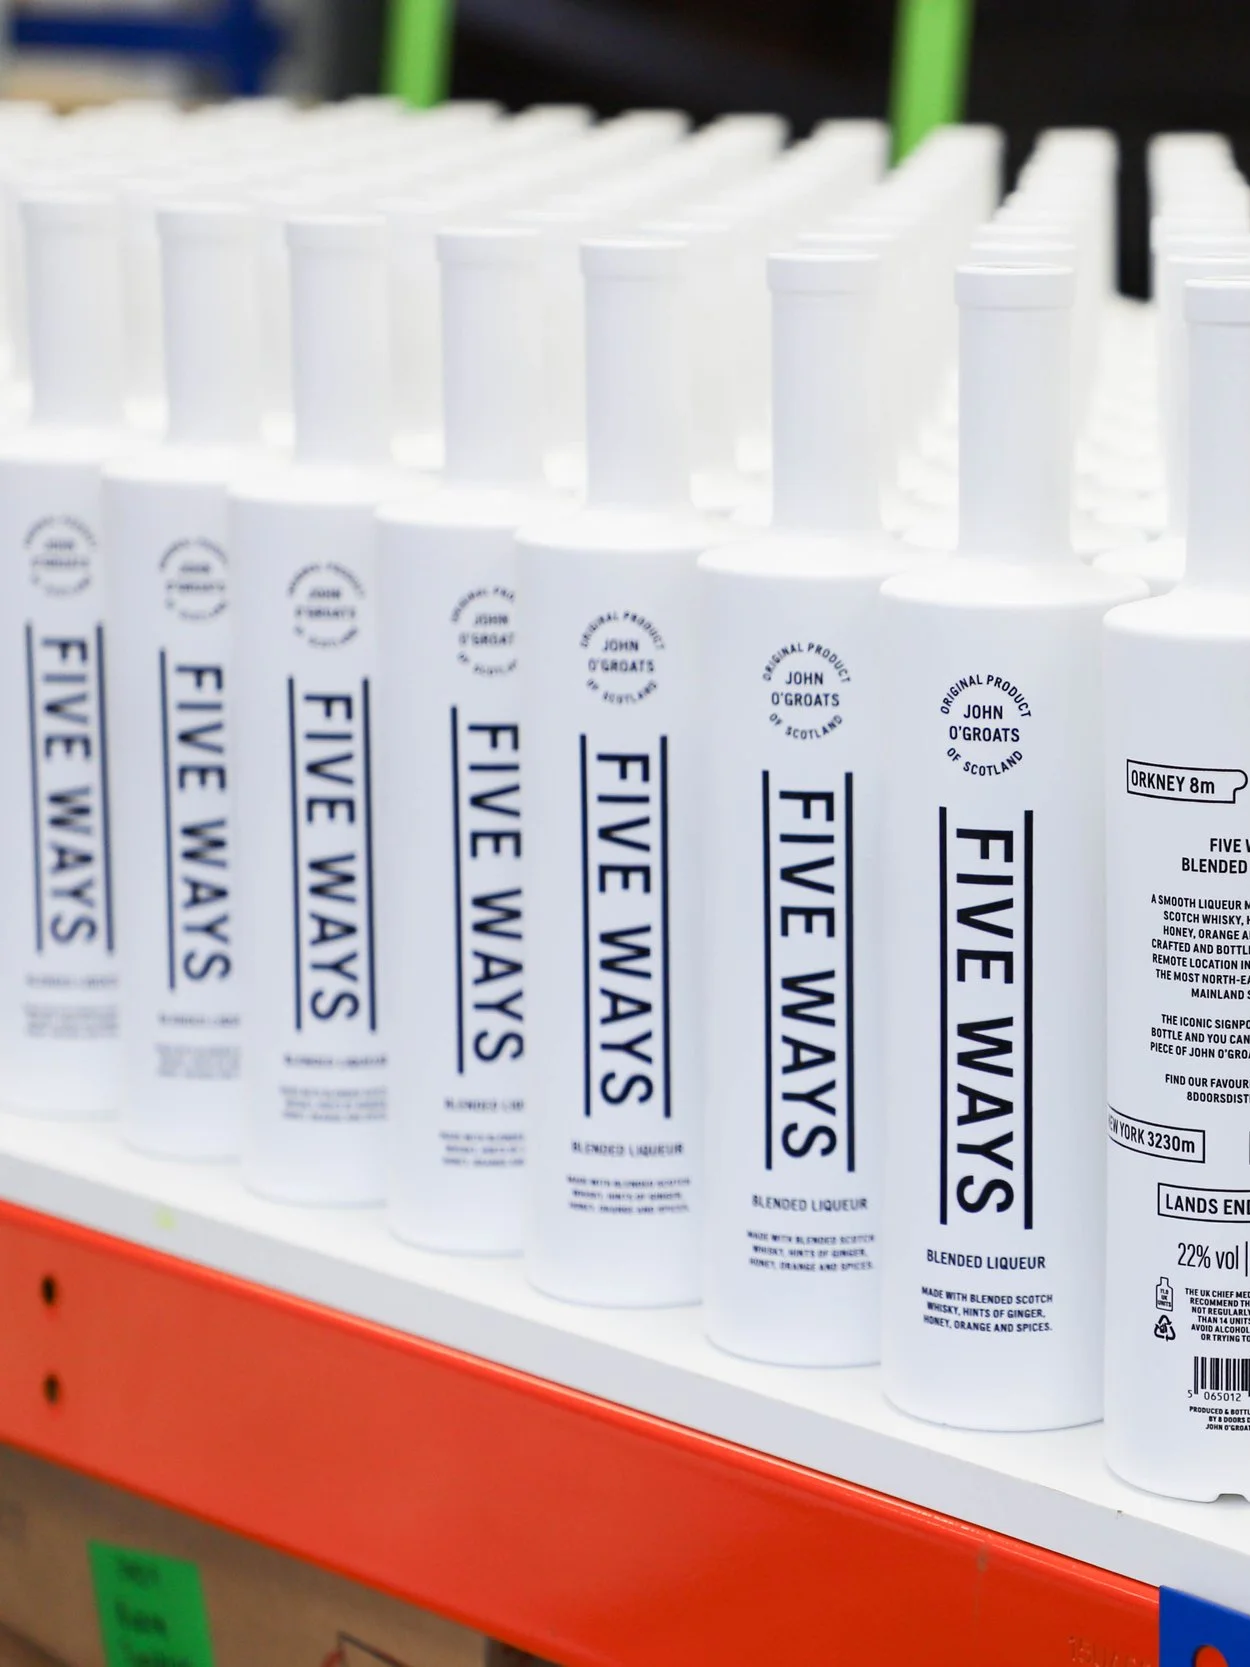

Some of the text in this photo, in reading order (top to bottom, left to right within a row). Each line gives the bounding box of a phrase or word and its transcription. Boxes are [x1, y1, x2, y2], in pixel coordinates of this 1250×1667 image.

[785, 671, 824, 686] JOHN
[771, 691, 840, 707] O'GROATS
[940, 674, 1032, 720] ORIGINAL PRODUCT
[963, 704, 1003, 720] JOHN
[174, 664, 228, 793] FIVE
[949, 725, 1020, 743] O'GROATS
[303, 692, 357, 826] FIVE
[946, 747, 1023, 777] OF SCOTLAND
[466, 722, 523, 860] FIVE
[1131, 769, 1215, 795] ORKNEY 8m
[595, 752, 652, 895] FIVE
[1210, 838, 1242, 853] FIVE
[1182, 857, 1248, 874] BLENDED
[179, 817, 233, 982] WAYS
[1151, 893, 1157, 904] A
[1158, 894, 1196, 908] SMOOTH
[1198, 898, 1242, 910] LIQUEUR
[1163, 910, 1200, 924] SCOTCH
[1201, 914, 1244, 927] WHISKY,
[306, 852, 361, 1022] WAYS
[1163, 925, 1196, 940] HONEY,
[1198, 928, 1240, 940] ORANGE
[1151, 938, 1191, 953] CRAFTED
[1192, 943, 1214, 955] AND
[1152, 953, 1188, 967] REMOTE
[1189, 958, 1238, 970] LOCATION
[470, 886, 525, 1064] WAYS
[778, 789, 838, 1159] FIVE WAYS
[1155, 968, 1172, 981] THE
[1173, 971, 1200, 983] MOST
[1191, 988, 1245, 1000] MAINLAND
[598, 923, 655, 1107] WAYS
[955, 827, 1015, 1214] FIVE WAYS
[1161, 1013, 1178, 1026] THE
[1180, 1016, 1213, 1029] ICONIC
[1151, 1027, 1183, 1041] BOTTLE
[1184, 1031, 1205, 1043] AND
[1206, 1033, 1227, 1044] YOU
[1229, 1034, 1250, 1045] CAN
[1150, 1041, 1174, 1055] PIECE
[1175, 1045, 1187, 1056] OF
[1188, 1047, 1215, 1058] JOHN
[1165, 1073, 1186, 1086] FIND
[1188, 1076, 1208, 1088] OUR
[1119, 1121, 1145, 1145] YORK
[1147, 1131, 1195, 1154] 3230m
[752, 1194, 867, 1212] BLENDED LIQUEUR
[1166, 1193, 1218, 1215] LANDS
[926, 1248, 1046, 1270] BLENDED LIQUEUR
[1177, 1242, 1211, 1269] 22%
[1215, 1245, 1239, 1270] vol
[921, 1286, 1053, 1305] MADE WITH BLENDED SCOTCH
[927, 1301, 1046, 1319] WHISKY, HINTS OF GINGER,
[923, 1314, 1052, 1333] HONEY, ORANGE AND SPICES.
[1187, 1389, 1193, 1398] 5
[1204, 1391, 1241, 1402] 065012
